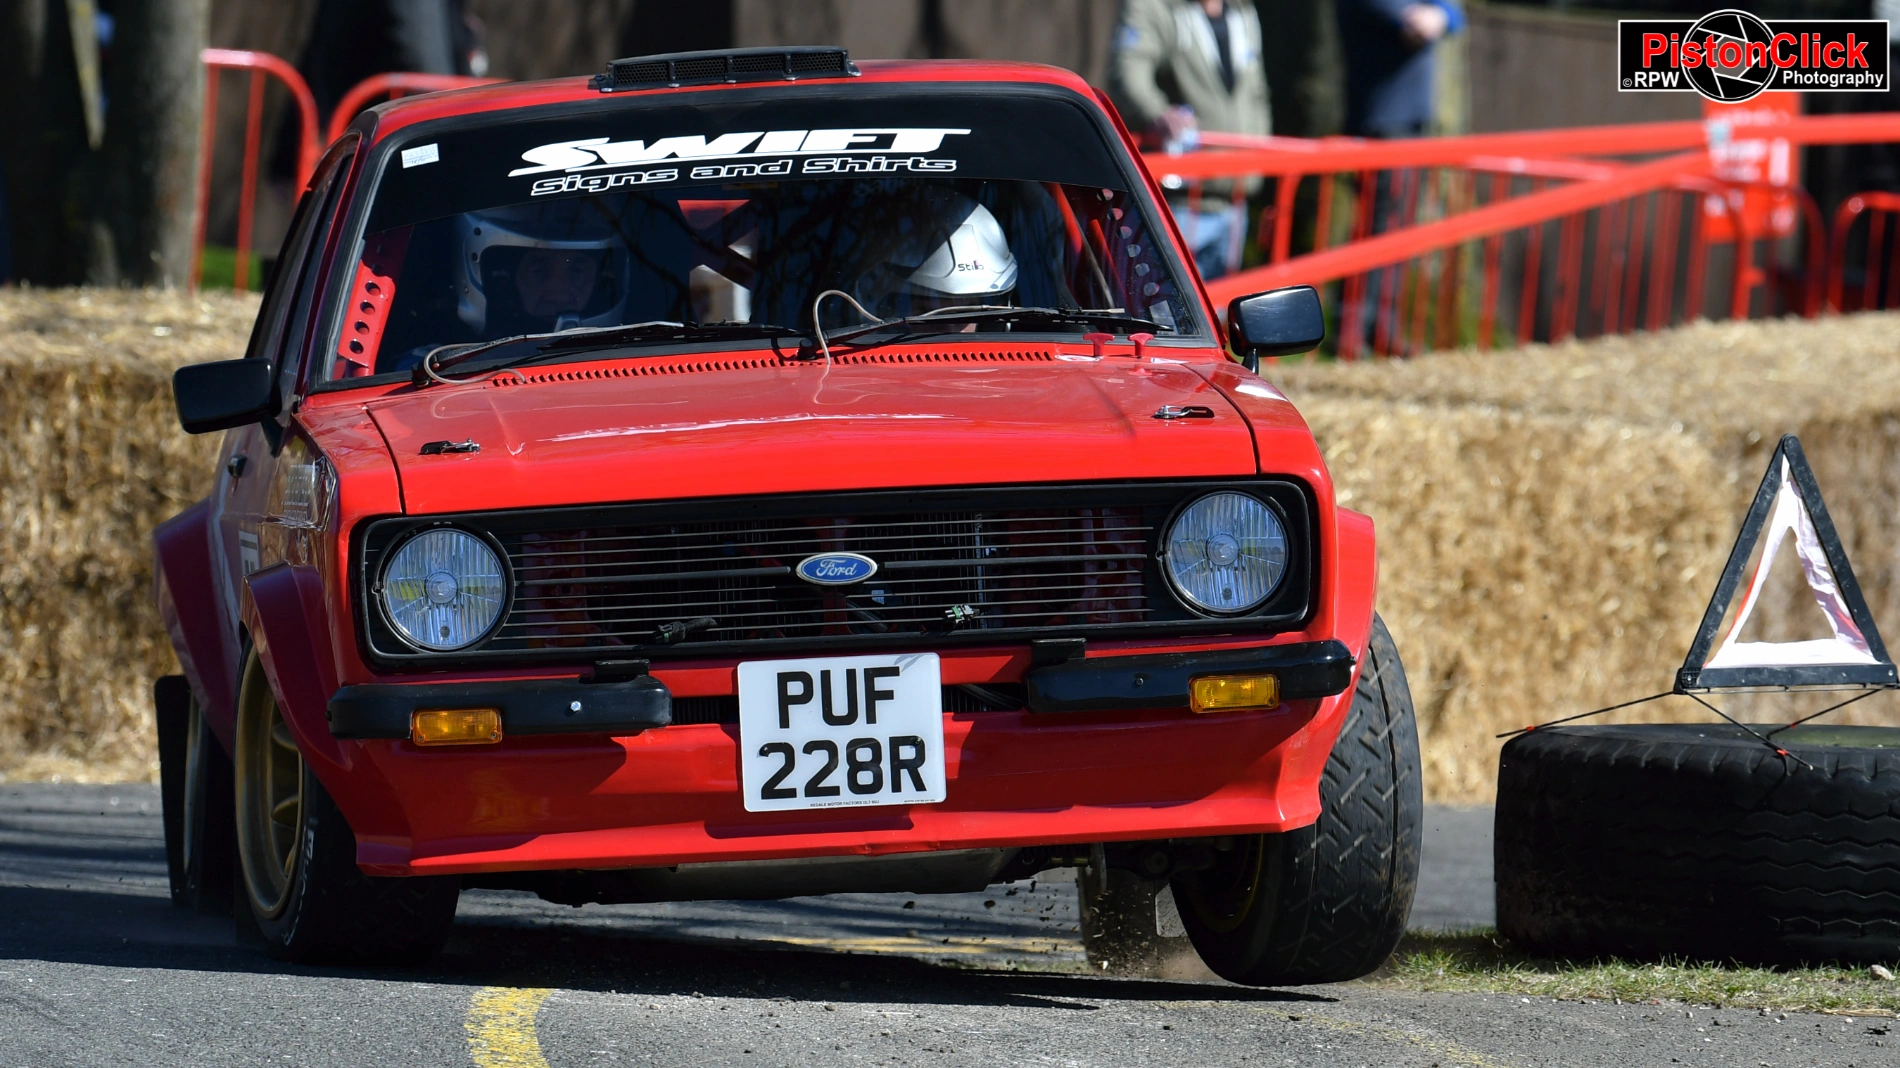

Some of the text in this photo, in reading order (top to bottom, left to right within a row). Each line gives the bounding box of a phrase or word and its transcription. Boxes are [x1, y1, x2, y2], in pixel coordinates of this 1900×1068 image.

[508, 128, 971, 177] SWIFT
[530, 156, 958, 196] Signs and Shirts
[815, 558, 859, 577] Ford
[777, 667, 900, 729] PUF
[758, 735, 928, 800] 228R
